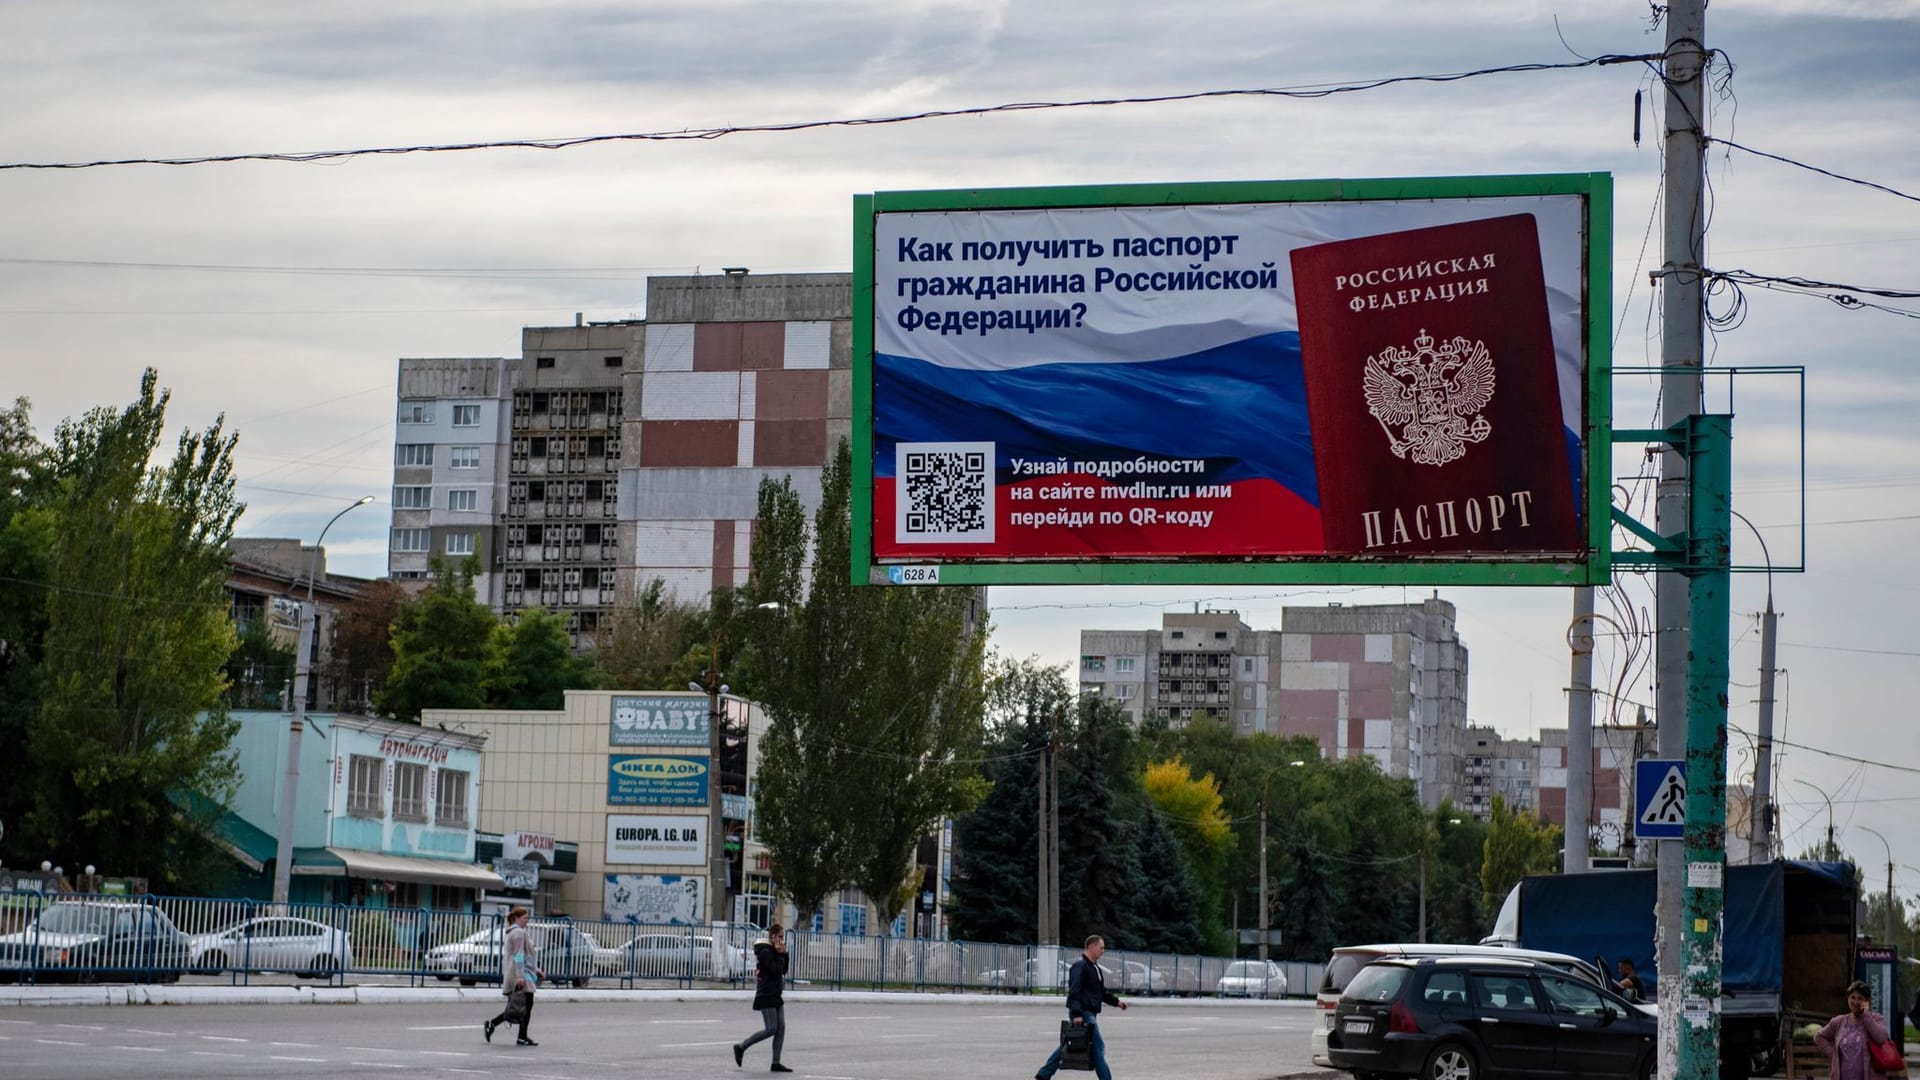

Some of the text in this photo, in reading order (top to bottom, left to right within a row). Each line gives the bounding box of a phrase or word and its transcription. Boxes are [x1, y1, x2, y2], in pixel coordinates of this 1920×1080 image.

[899, 234, 1239, 265] Как получить паспорт
[898, 262, 1277, 300] гражданина Российской
[1335, 253, 1496, 290] РОССИЙСКАЯ
[1350, 278, 1489, 312] ФЕДЕРАЦИЯ
[898, 303, 1087, 335] Федерации?
[1011, 456, 1205, 477] Узнай подробности
[1011, 481, 1232, 500] на сайте mvdlnr.ru или
[1010, 508, 1214, 529] перейди по QR-коду
[1361, 490, 1532, 548] ПАСПОРТ
[904, 569, 925, 581] 628
[635, 710, 701, 730] BABY
[621, 764, 699, 774] ИКЕА ДОМ
[518, 833, 554, 849] АГРОХІМ
[616, 827, 697, 842] EUROPA. LG. UA
